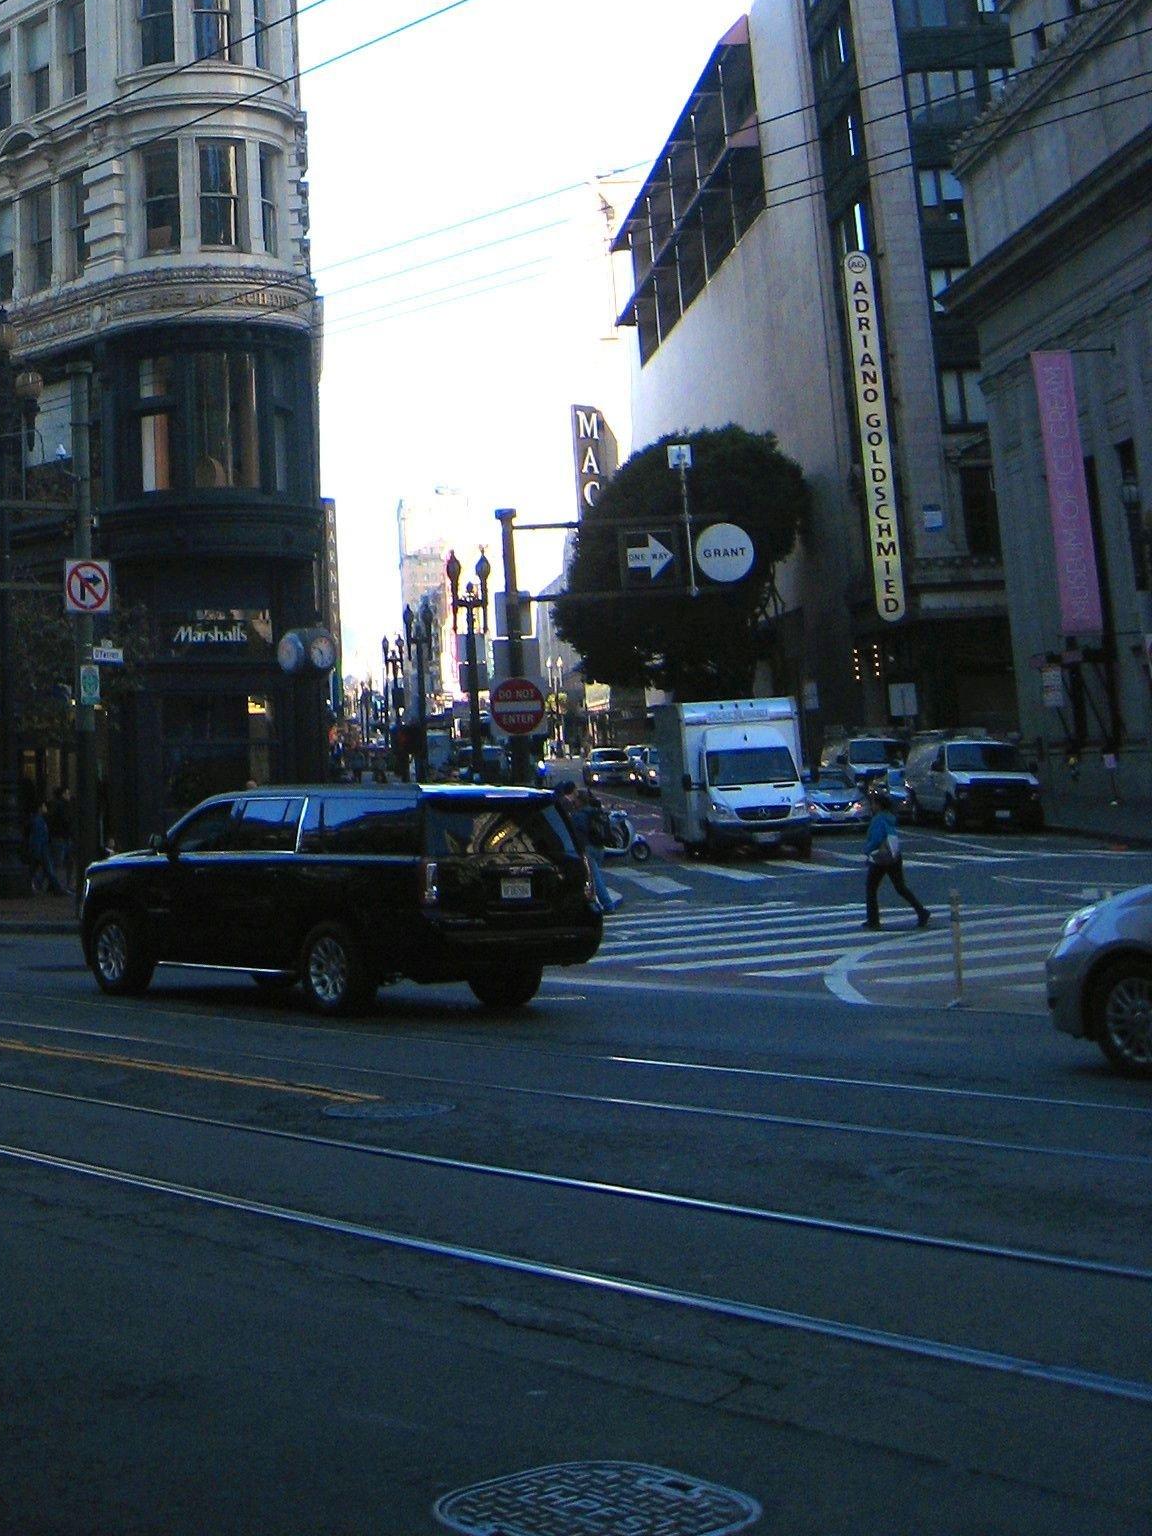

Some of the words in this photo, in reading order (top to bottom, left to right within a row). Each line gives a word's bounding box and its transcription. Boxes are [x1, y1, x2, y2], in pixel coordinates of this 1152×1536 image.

[1042, 365, 1069, 440] CREAM
[853, 281, 879, 403] ADRIANO
[866, 413, 899, 613] GOLDSCHMIED
[1052, 443, 1075, 481] ICE
[1056, 488, 1079, 519] OF
[628, 553, 645, 561] ONE
[650, 552, 668, 560] WAY
[702, 547, 747, 558] GRANT
[1062, 527, 1090, 620] MUSEUM
[173, 623, 248, 643] Marshalls
[498, 689, 513, 699] DO
[515, 688, 535, 699] NOT
[503, 713, 535, 725] ENTER
